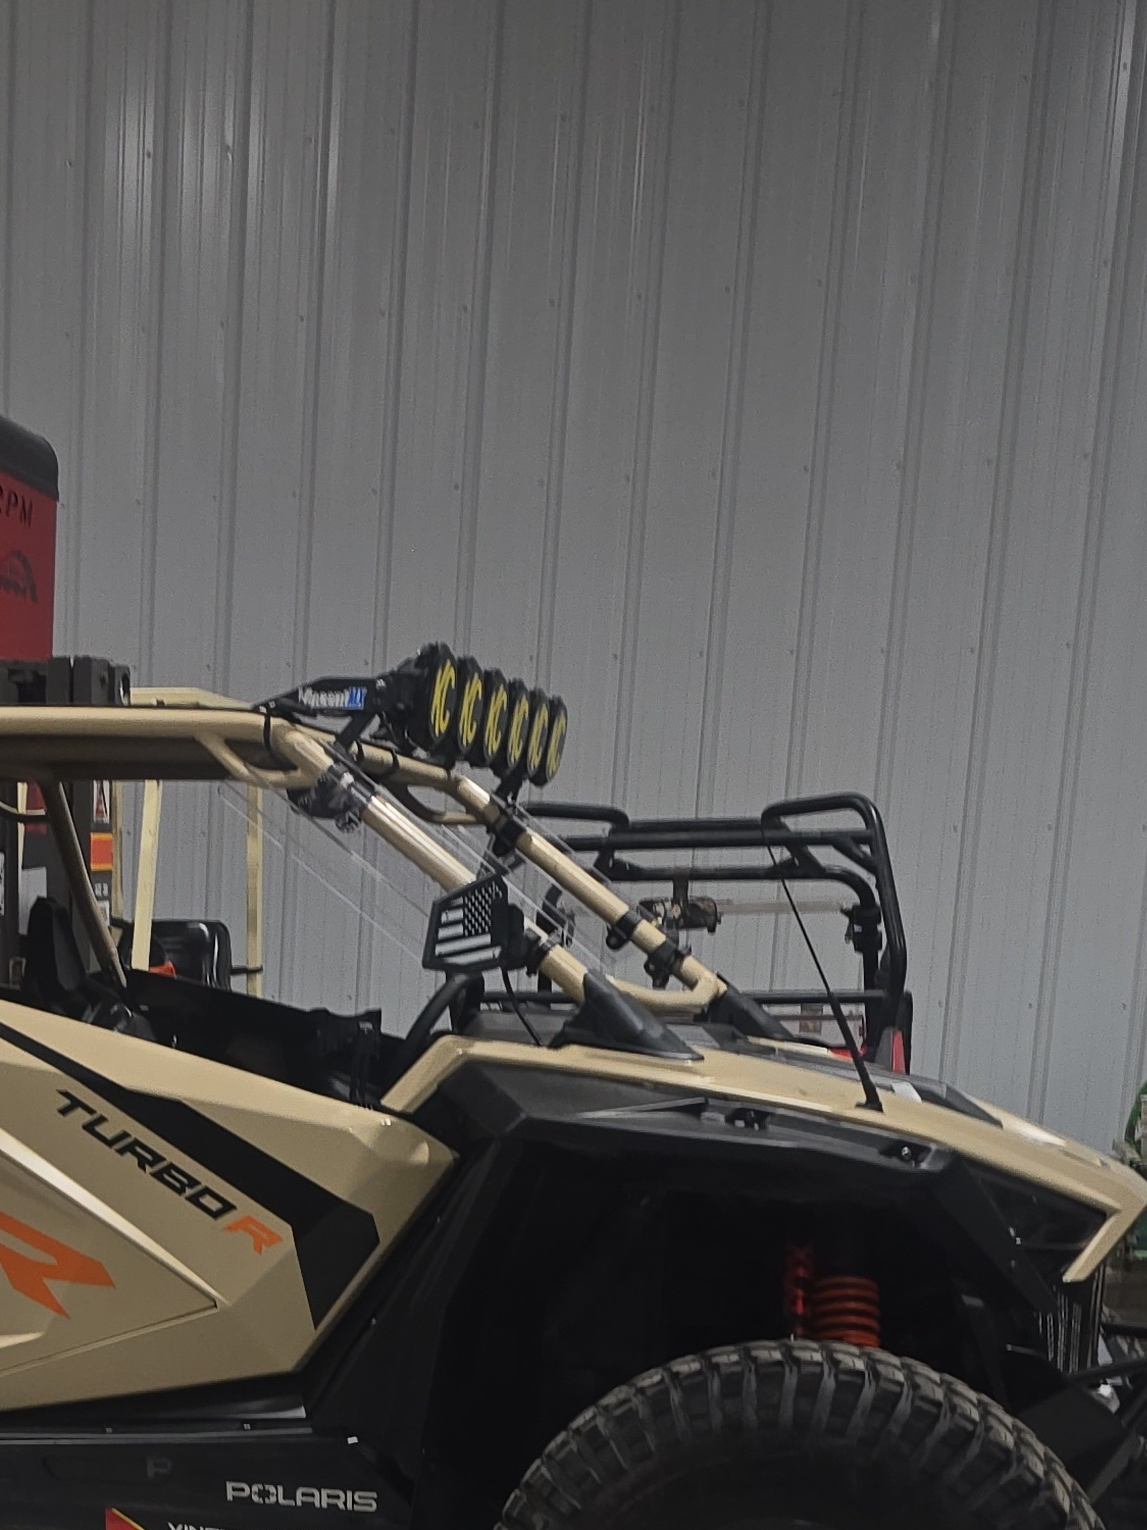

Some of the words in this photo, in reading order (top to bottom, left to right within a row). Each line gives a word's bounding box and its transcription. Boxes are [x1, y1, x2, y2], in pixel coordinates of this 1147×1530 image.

[56, 1089, 238, 1222] TURBO
[224, 1215, 283, 1255] R
[226, 1481, 378, 1512] POLARIS
